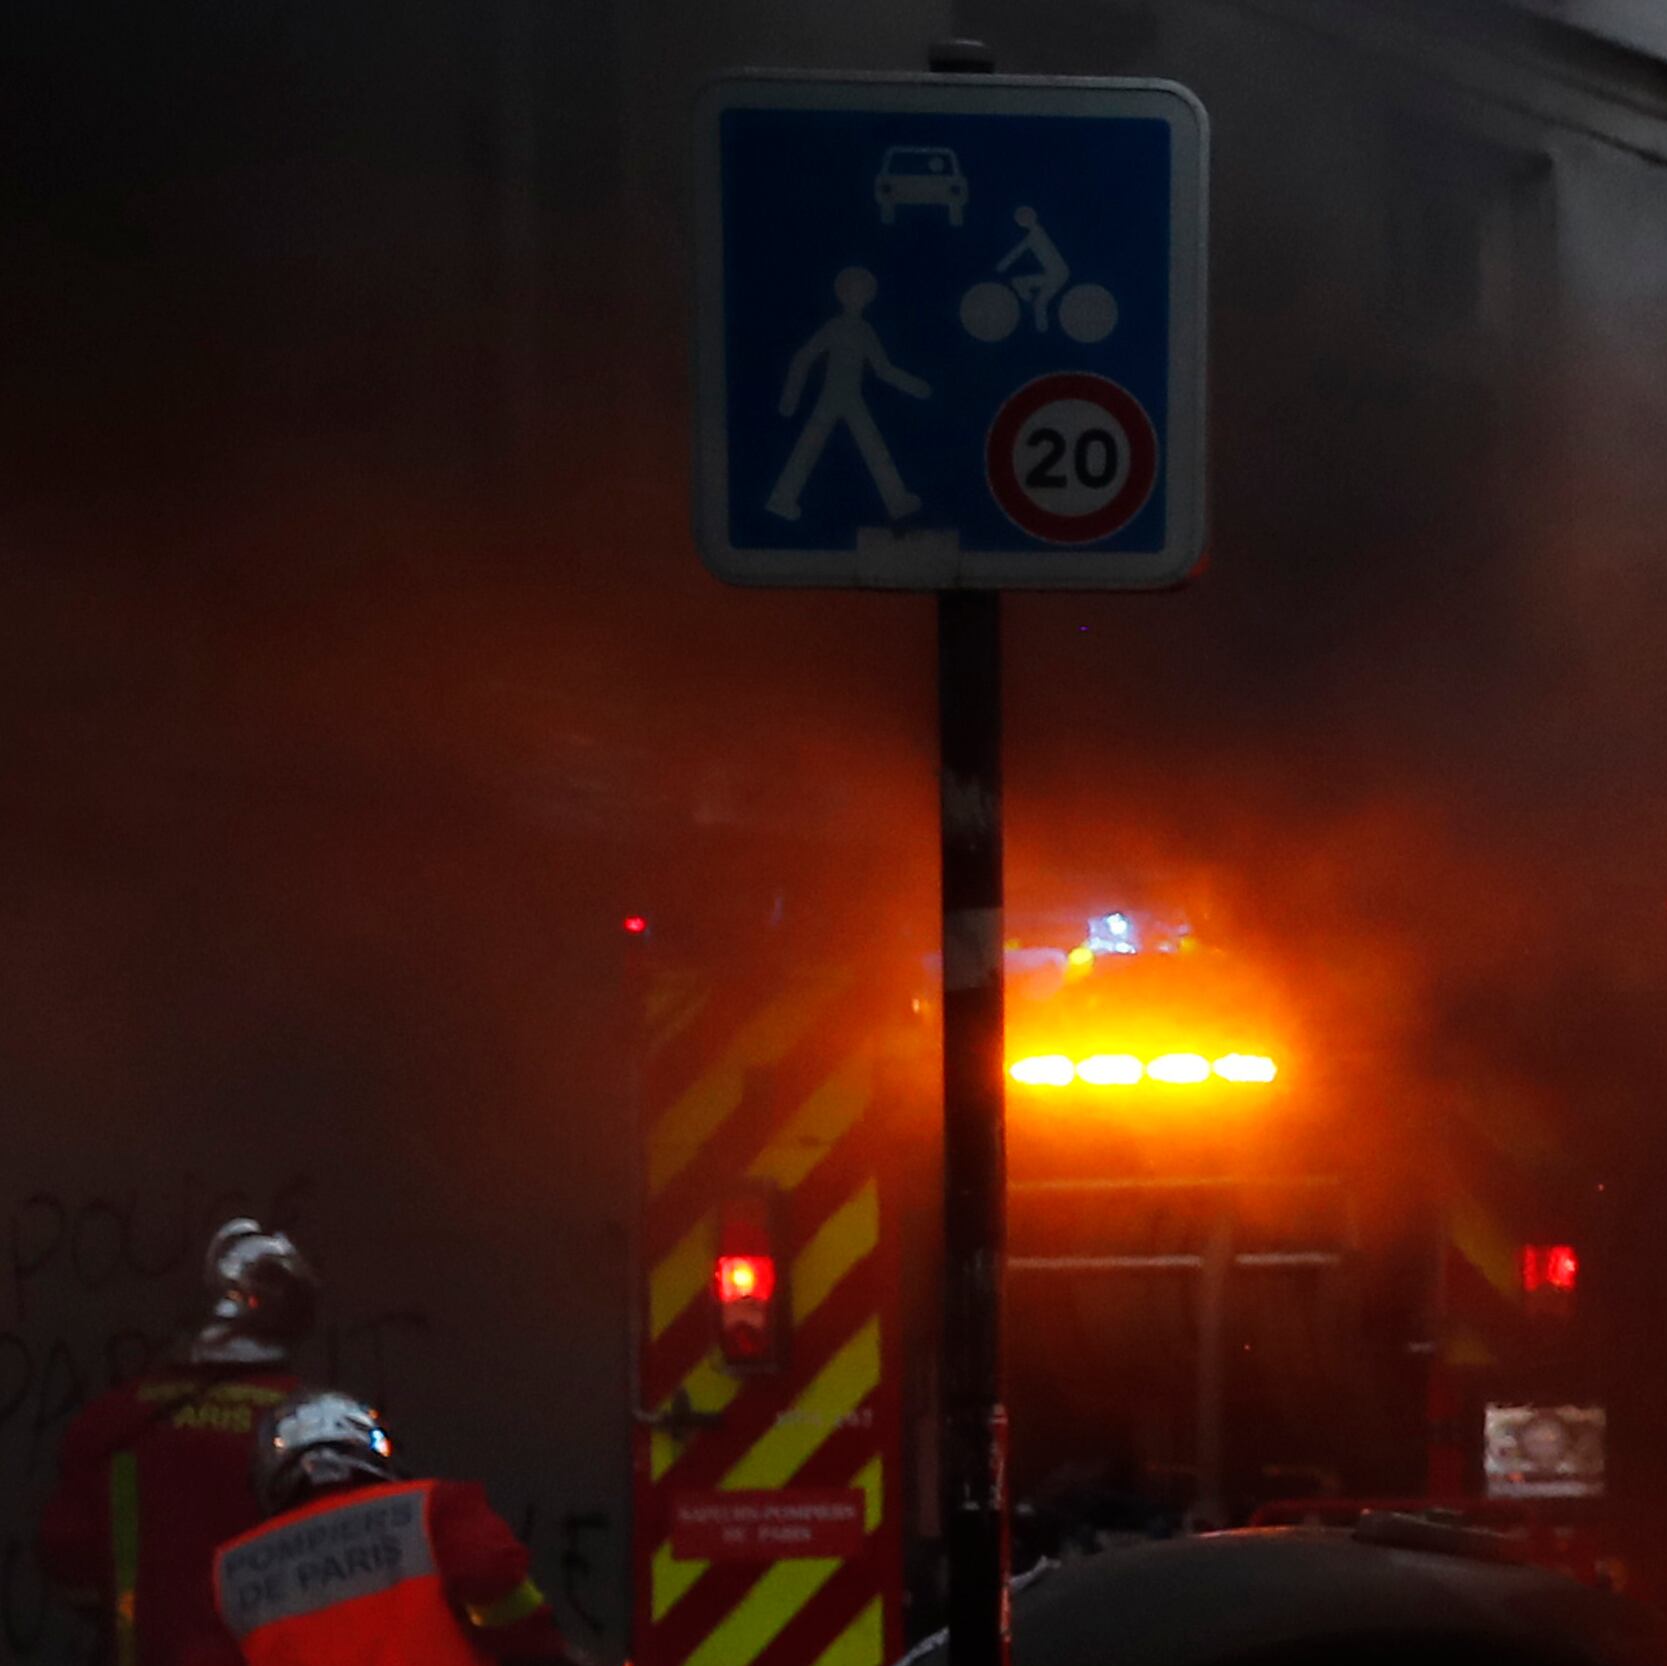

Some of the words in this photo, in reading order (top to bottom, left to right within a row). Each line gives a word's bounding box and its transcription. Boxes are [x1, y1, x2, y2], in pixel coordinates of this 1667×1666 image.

[1024, 427, 1118, 489] 20
[224, 1501, 413, 1581] POMPIERS
[296, 1534, 403, 1591] PARIS
